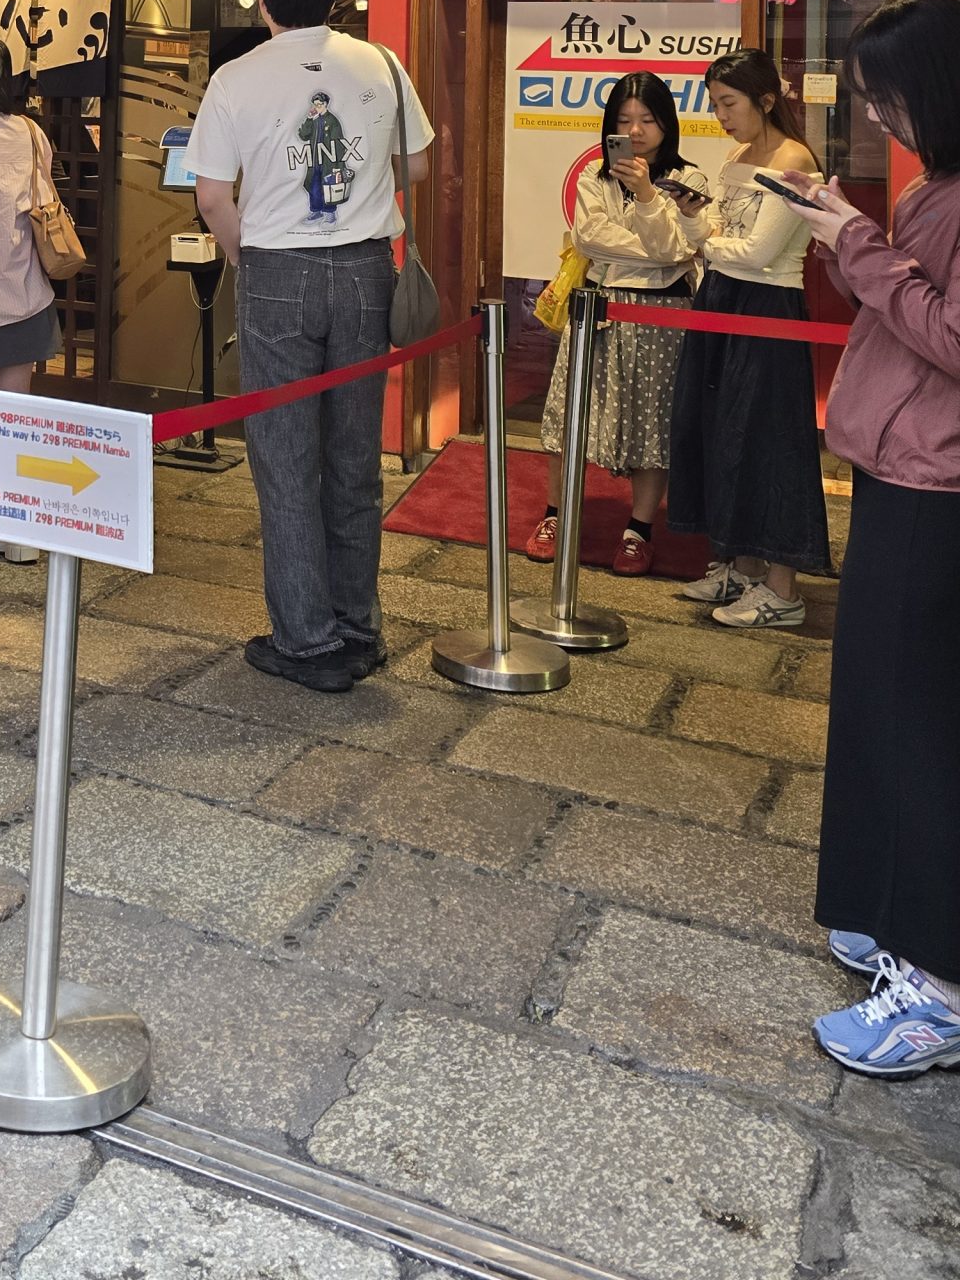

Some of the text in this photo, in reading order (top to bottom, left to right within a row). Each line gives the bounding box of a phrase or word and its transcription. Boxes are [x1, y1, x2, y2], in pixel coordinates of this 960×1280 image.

[560, 12, 652, 54] 魚心
[520, 117, 535, 126] The
[536, 119, 572, 128] entrance
[573, 120, 581, 128] is
[582, 121, 600, 129] over
[286, 136, 365, 170] MNX
[12, 429, 29, 442] way
[31, 431, 41, 442] to
[42, 433, 60, 446] 298
[62, 437, 101, 453] PREMIUM
[103, 444, 130, 458] Namba
[56, 421, 122, 442] 難波店はこちら
[3, 491, 40, 507] PREMIUM
[35, 512, 53, 525] 298
[54, 516, 94, 534] PREMIUM
[95, 523, 125, 541] 難波店
